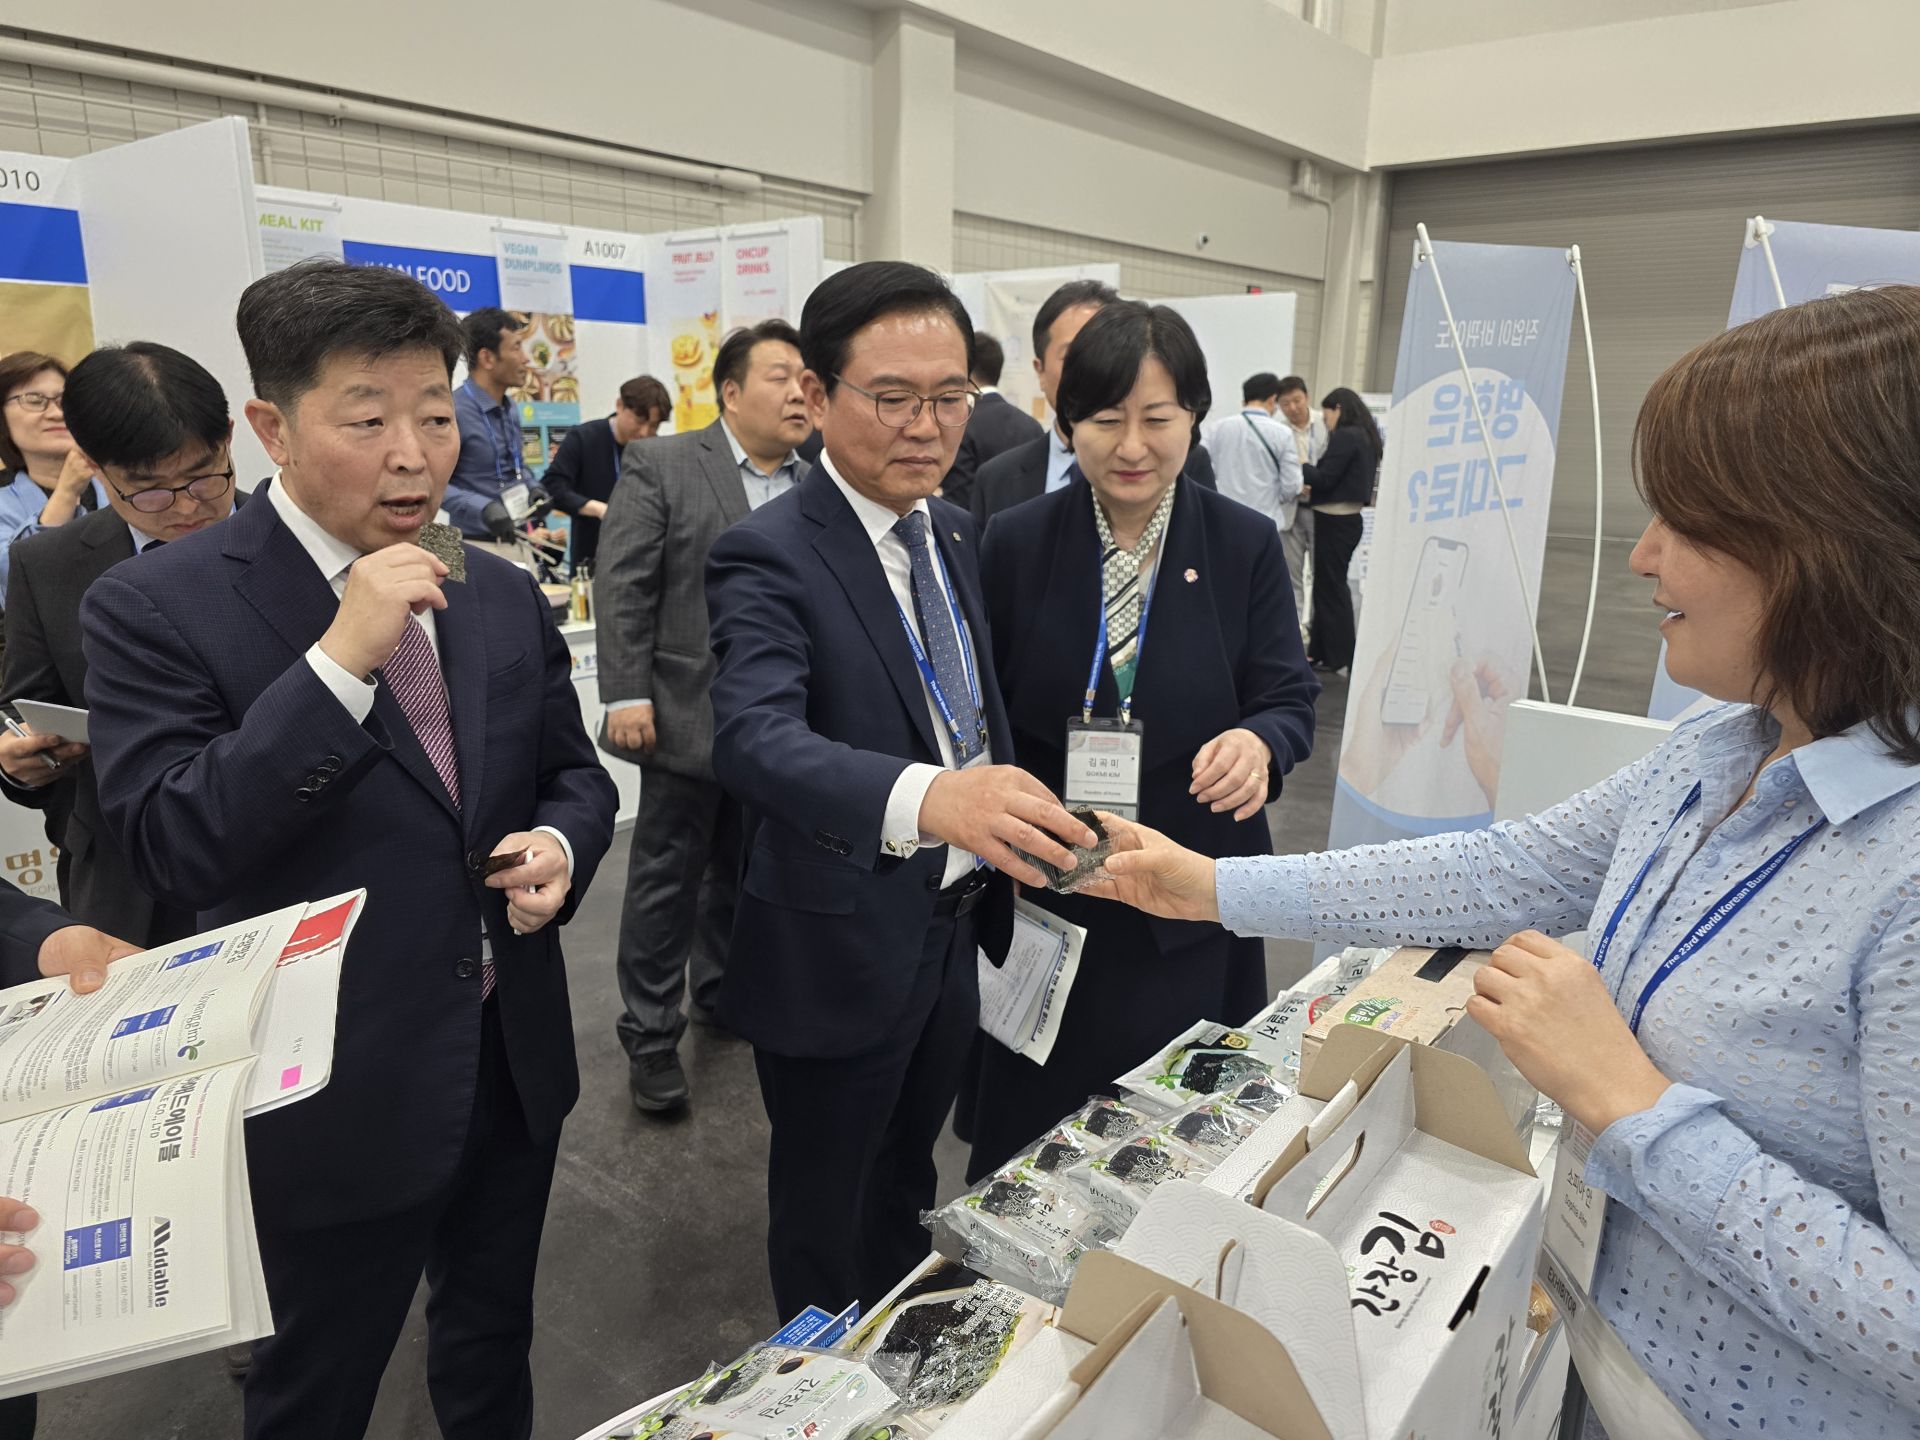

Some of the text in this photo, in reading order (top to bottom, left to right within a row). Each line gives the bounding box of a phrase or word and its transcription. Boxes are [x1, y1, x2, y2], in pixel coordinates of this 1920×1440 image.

[300, 217, 324, 232] KIT
[503, 242, 538, 256] VEGAN
[584, 240, 626, 259] A1007
[504, 258, 563, 274] DUMPLINGS
[736, 262, 771, 275] DRINKS
[416, 267, 472, 293] FOOD
[1663, 854, 1787, 970] The 23rd World Korean Business
[150, 1122, 160, 1139] LTD
[1566, 1167, 1587, 1201] 소피아
[1584, 1188, 1593, 1209] 안
[1546, 1266, 1577, 1318] EXHIBITOR
[757, 1375, 821, 1420] 간장김
